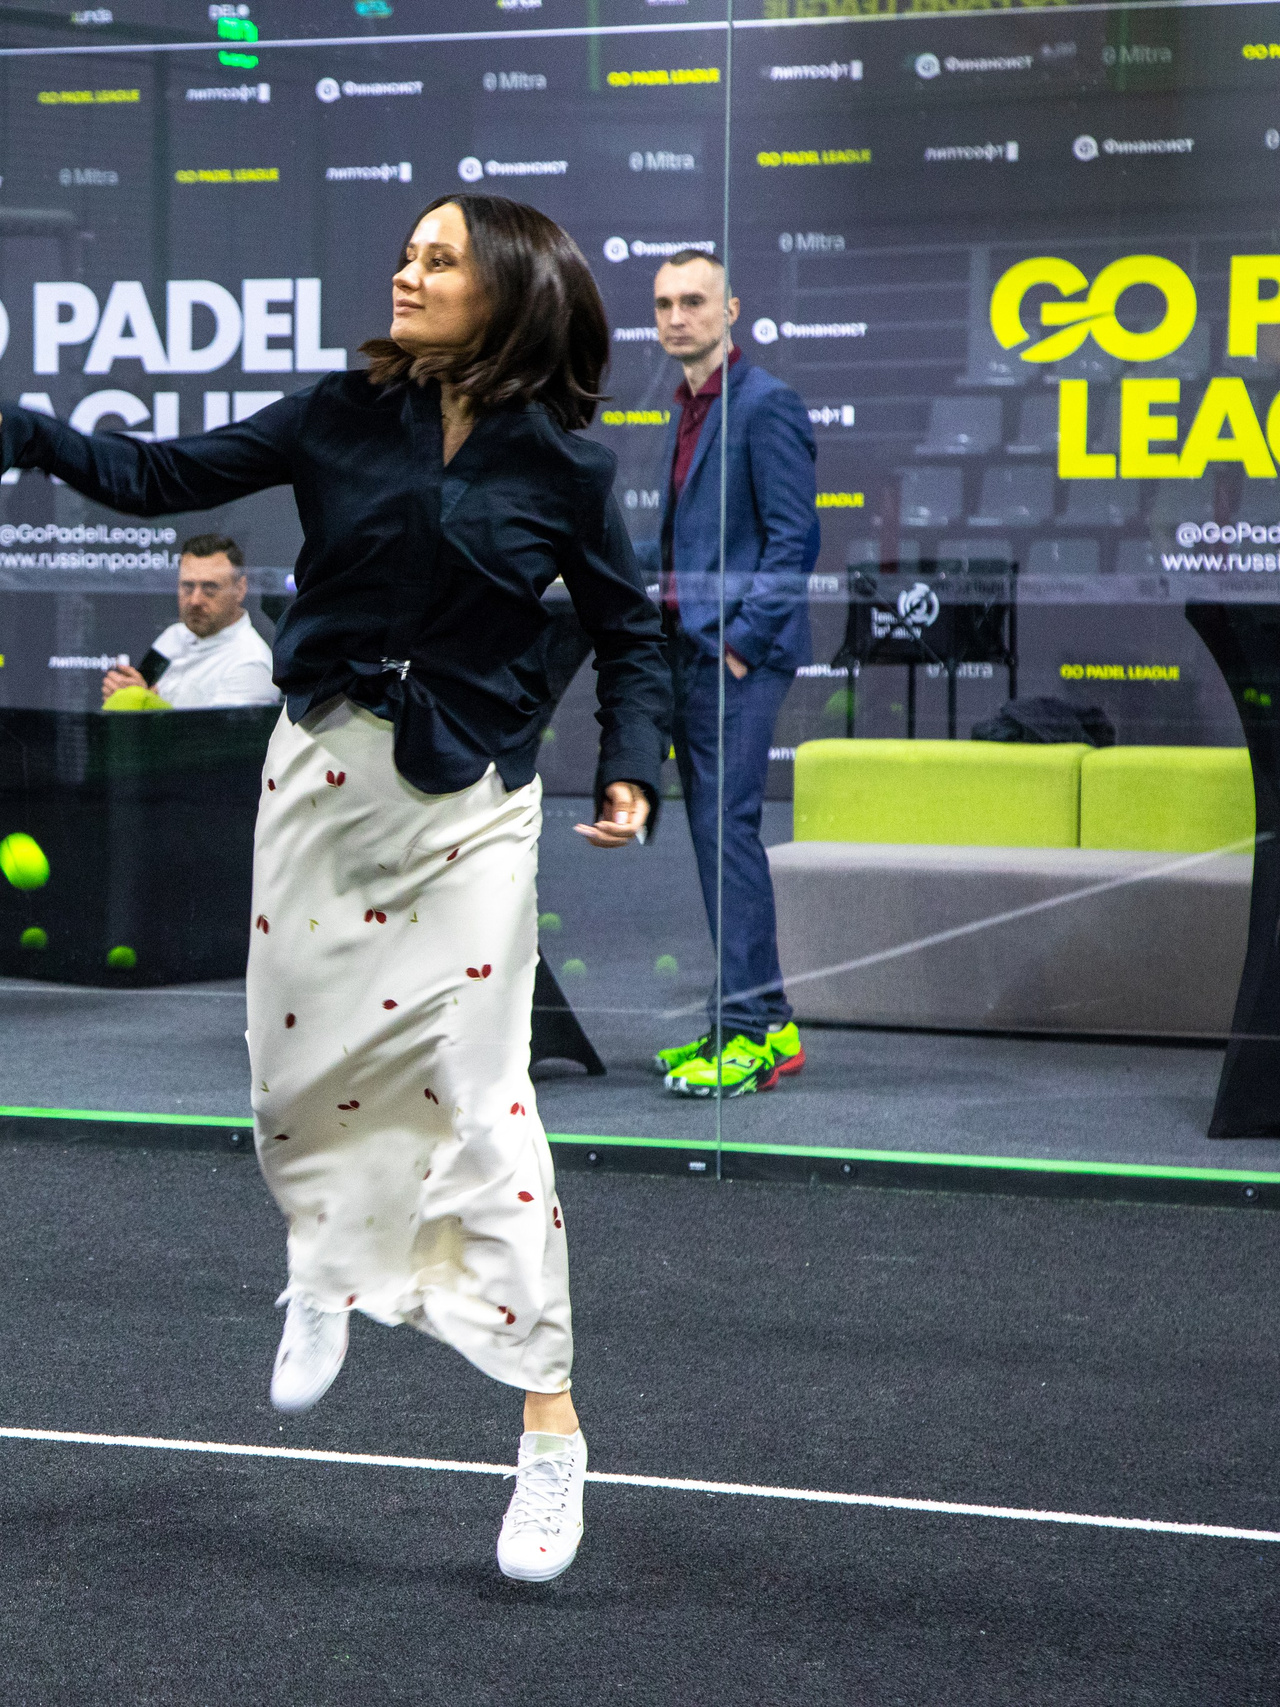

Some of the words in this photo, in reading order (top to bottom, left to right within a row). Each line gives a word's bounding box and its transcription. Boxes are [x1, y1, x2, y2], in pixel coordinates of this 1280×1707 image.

[1120, 44, 1172, 64] Mitra
[499, 71, 547, 90] Mitra
[1103, 138, 1194, 153] Финансист
[645, 151, 695, 170] Mitra
[74, 168, 119, 185] Mitra
[796, 232, 845, 251] Mitra
[990, 254, 1197, 363] GO
[33, 278, 347, 374] PADEL
[780, 322, 867, 338] Финансист
[1058, 377, 1280, 479] LEA
[1161, 552, 1280, 572] www.russ
[1059, 663, 1084, 680] GO
[1085, 663, 1126, 681] PADEL
[1128, 663, 1180, 681] LEAGUE
